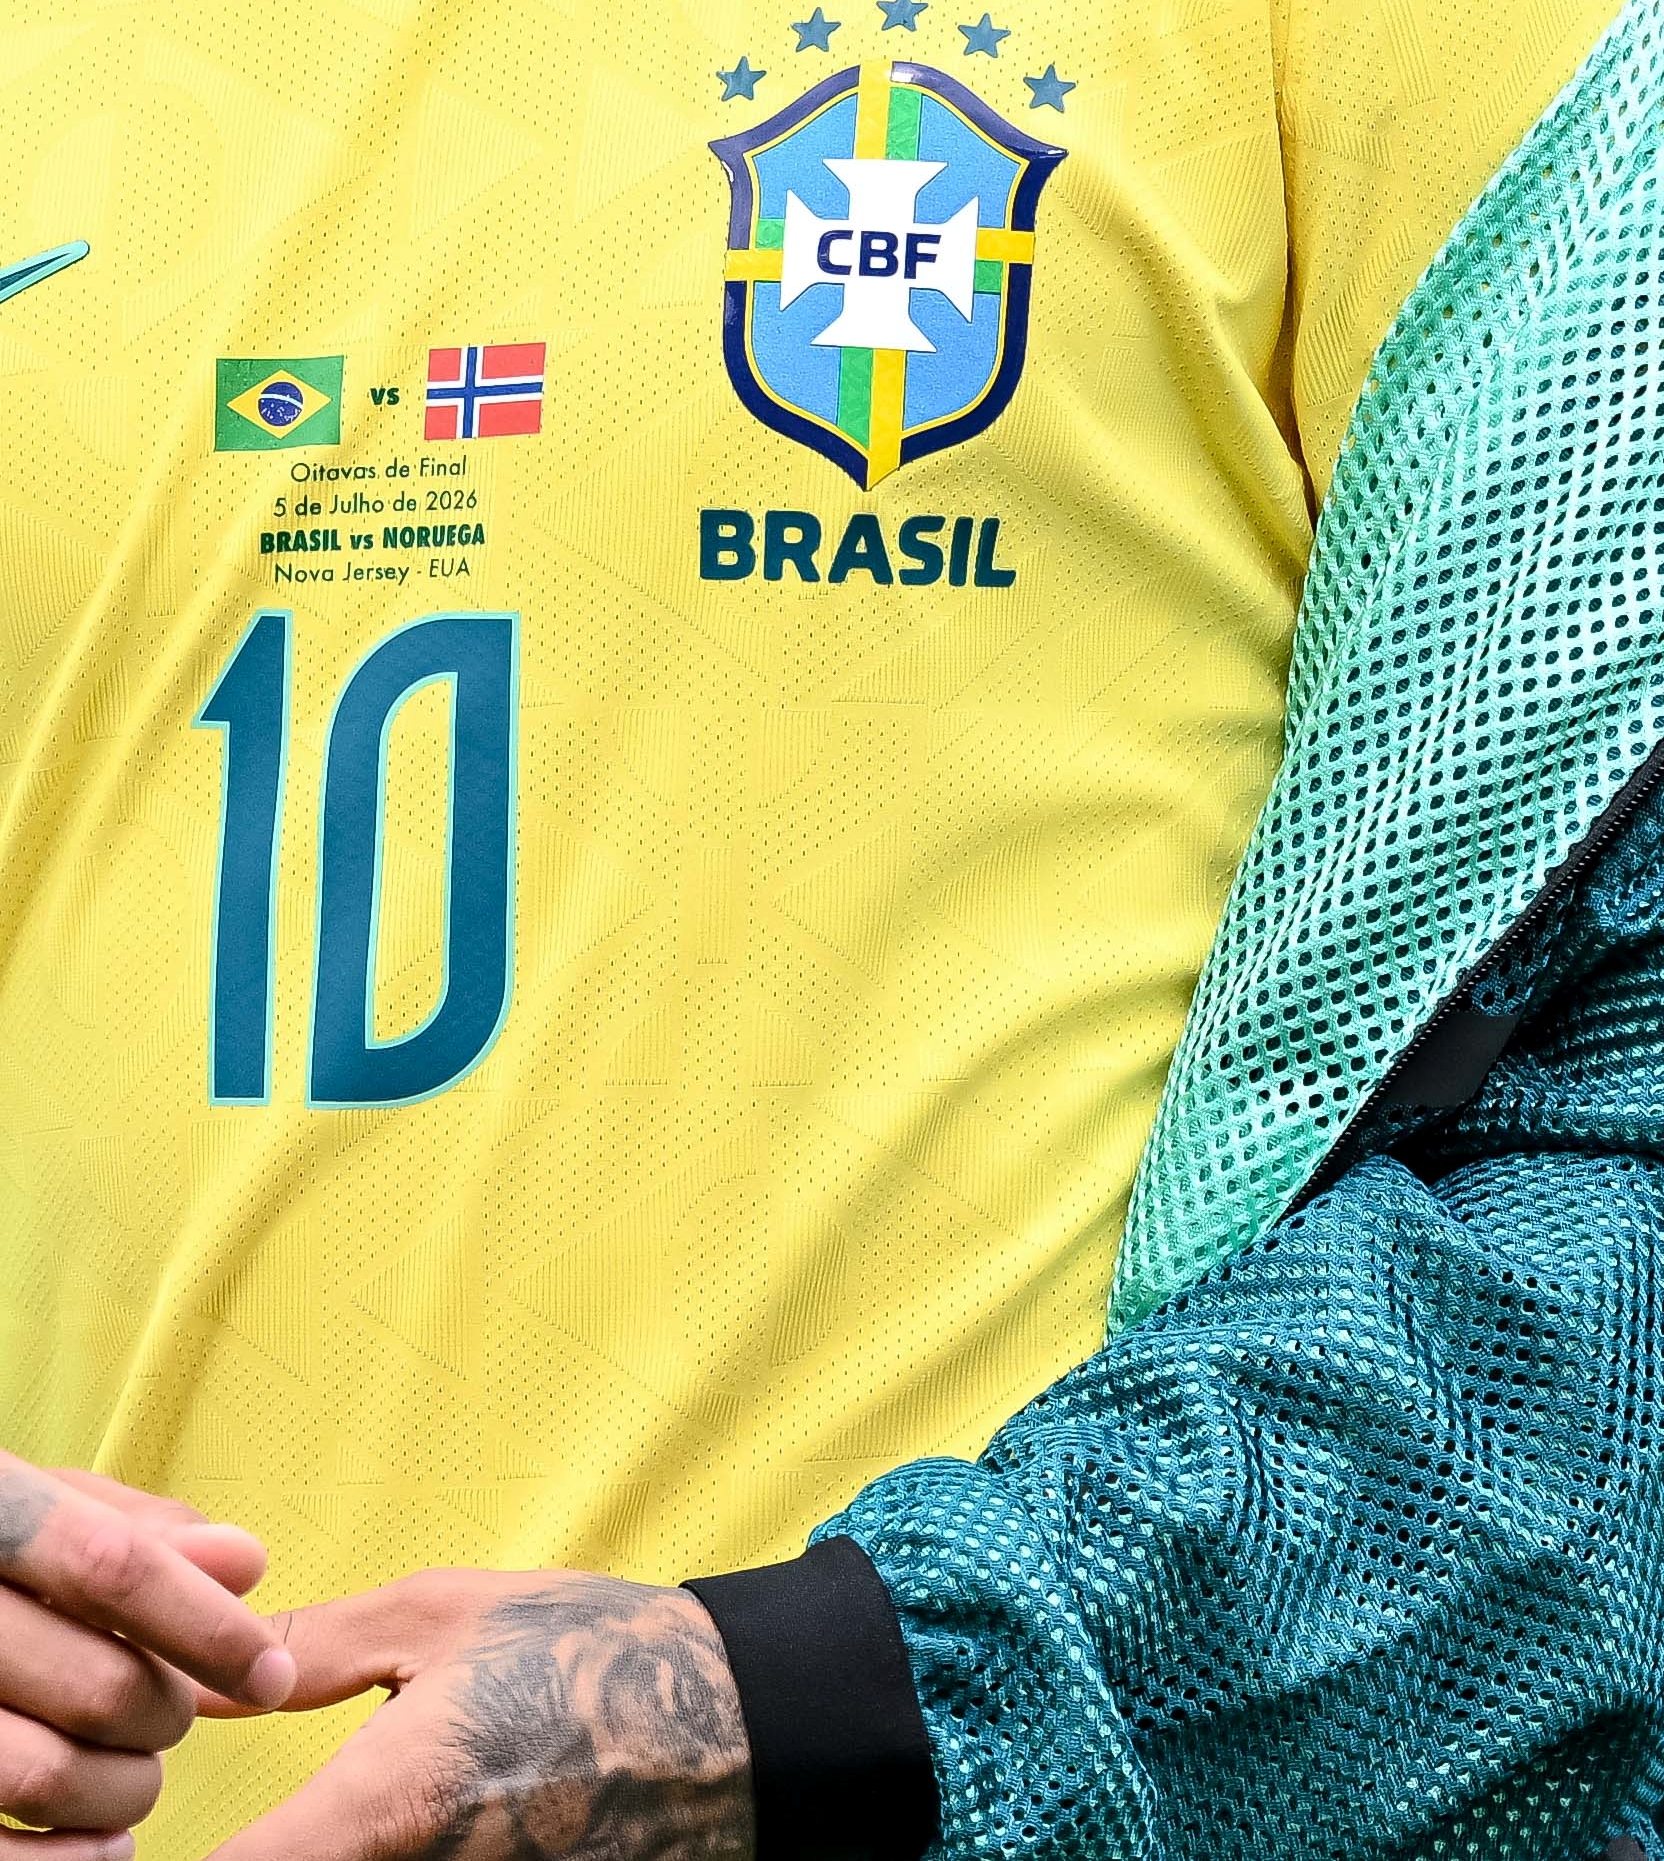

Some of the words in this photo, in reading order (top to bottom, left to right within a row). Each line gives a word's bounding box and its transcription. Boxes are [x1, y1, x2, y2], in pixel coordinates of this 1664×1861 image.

[816, 228, 941, 280] CBF
[290, 462, 376, 482] Oitavas
[385, 457, 410, 478] de
[419, 455, 467, 477] Final
[273, 497, 287, 517] 5
[294, 494, 322, 516] de
[329, 492, 384, 515] Julho
[392, 491, 417, 512] de
[426, 490, 478, 511] 2026
[260, 528, 342, 555] BRASIL
[349, 533, 374, 550] vs
[382, 523, 486, 549] NORUEGA
[699, 507, 1016, 588] BRASIL
[274, 563, 334, 584] Nova
[342, 561, 409, 586] Jersey
[429, 557, 470, 578] EUA
[191, 607, 521, 1110] 10
